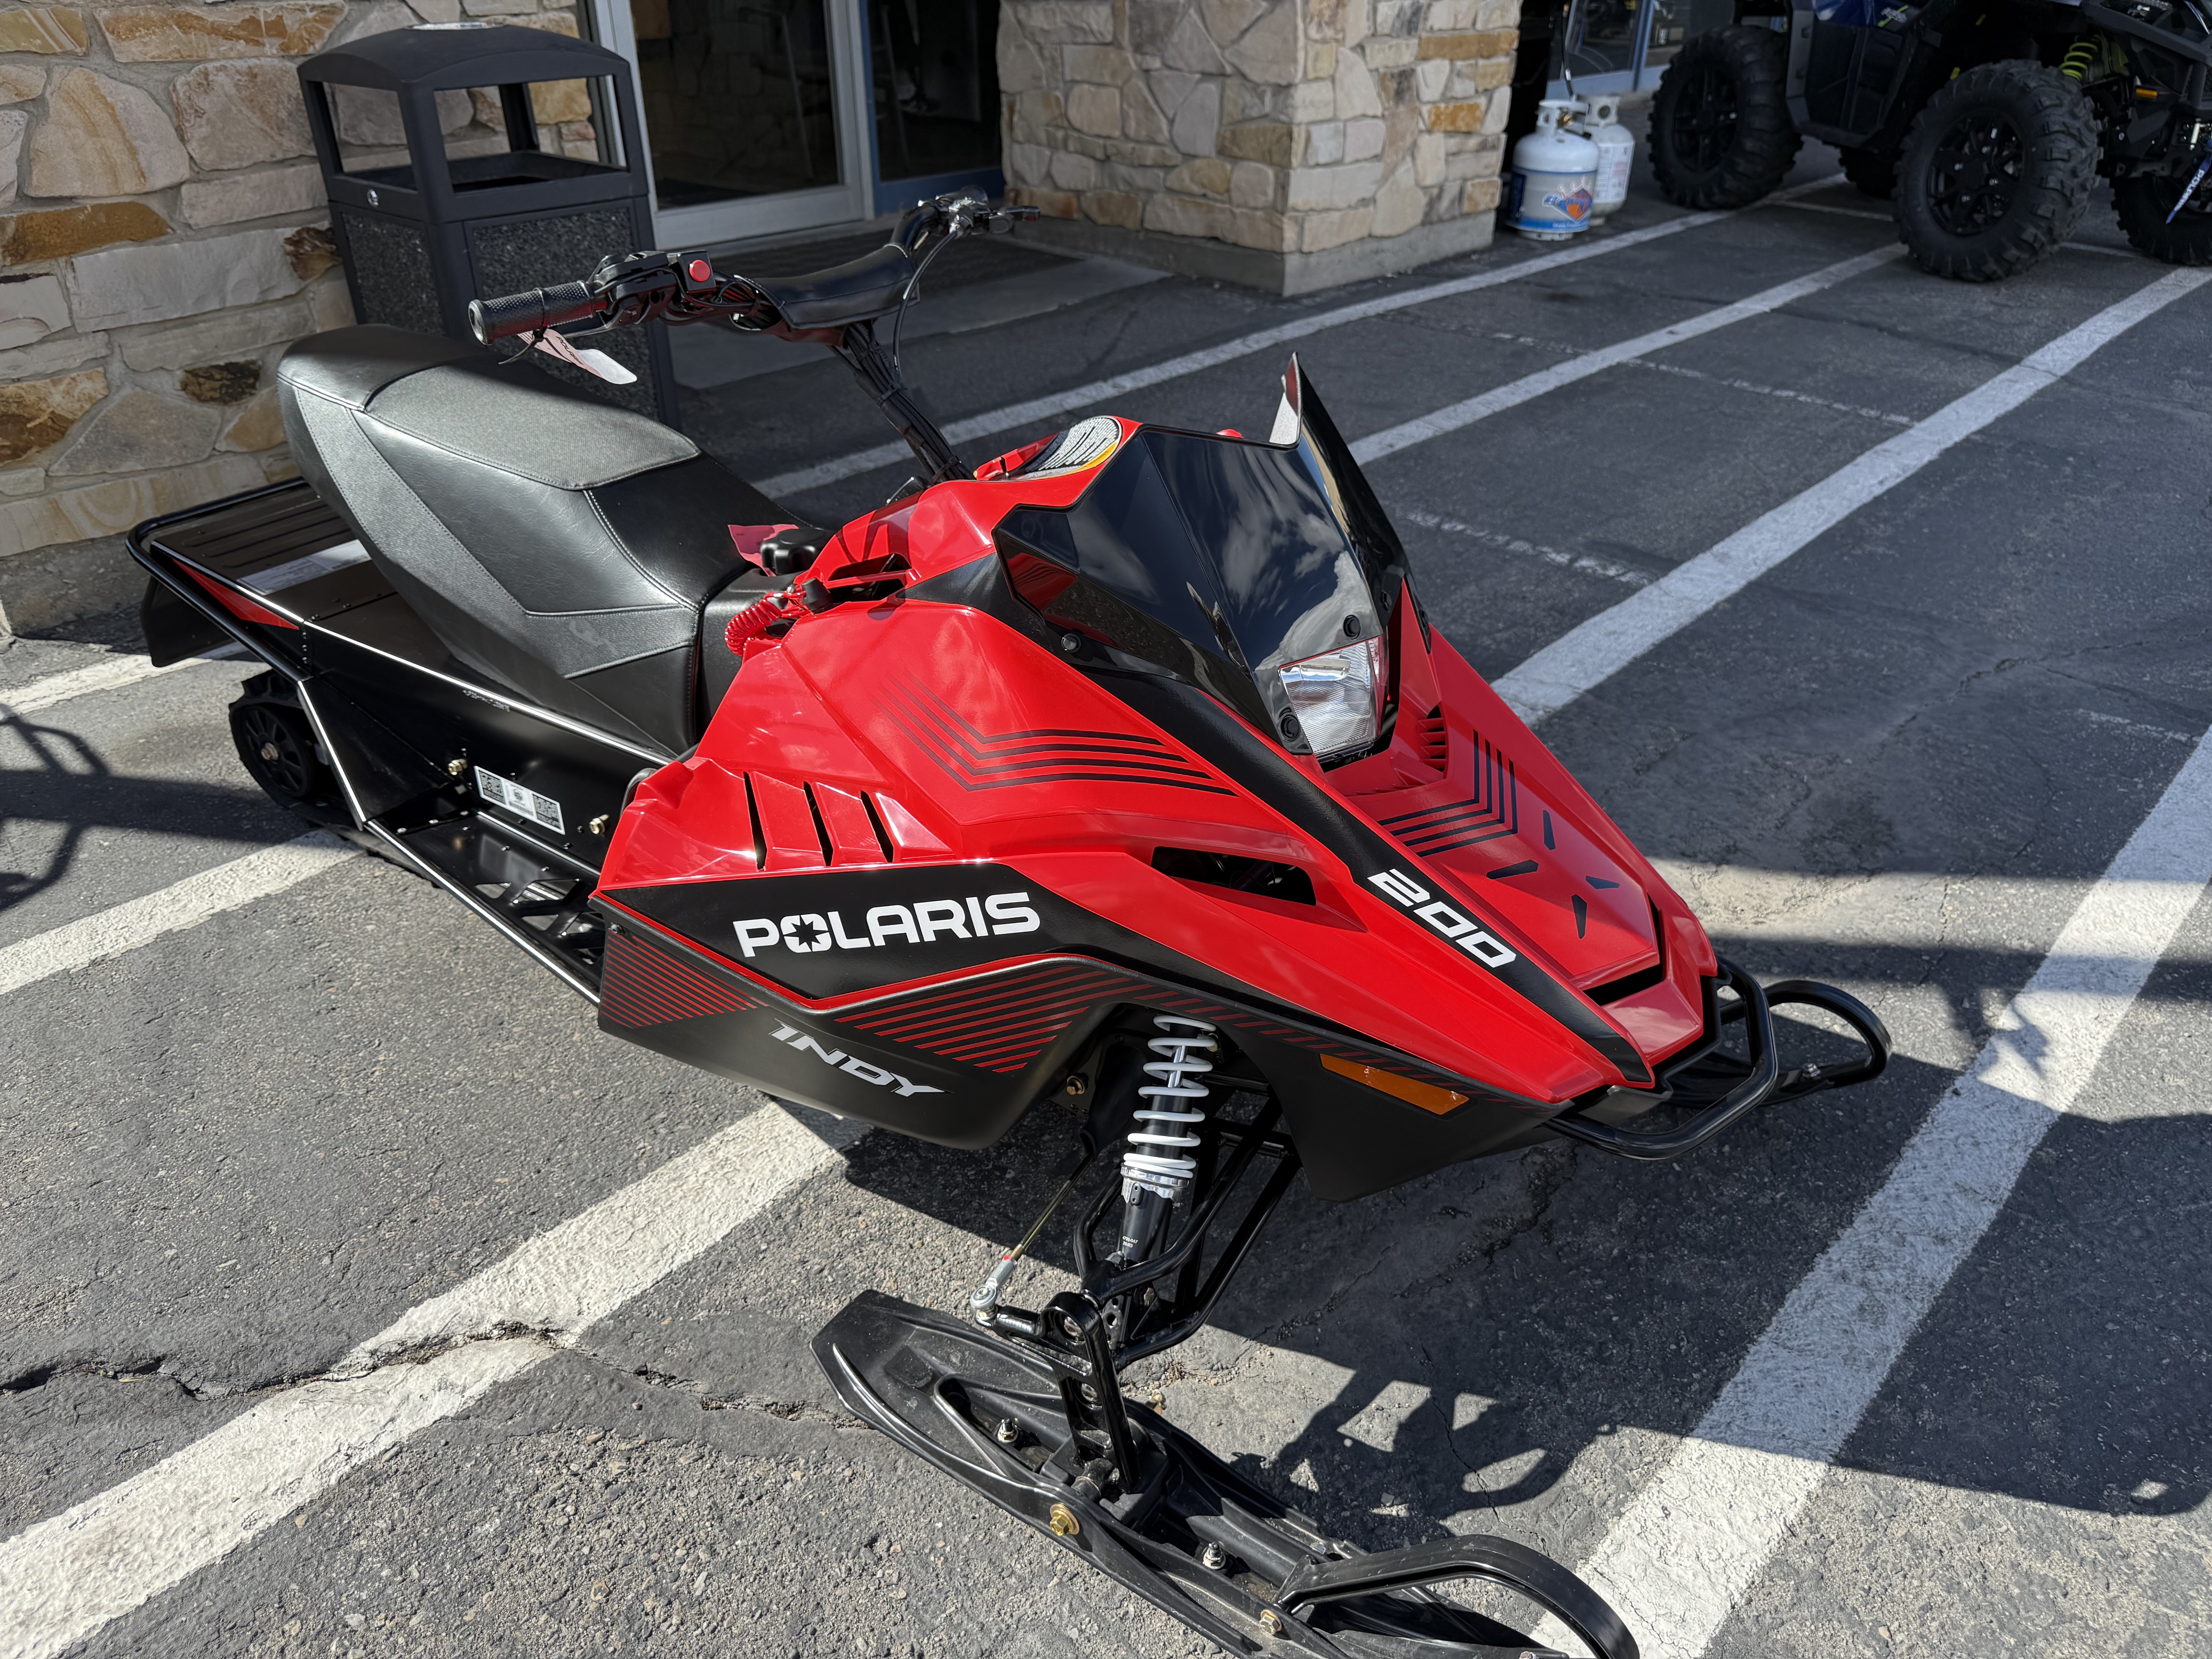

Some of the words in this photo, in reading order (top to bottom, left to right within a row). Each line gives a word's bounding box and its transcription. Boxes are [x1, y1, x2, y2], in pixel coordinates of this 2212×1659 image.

[555, 336, 584, 365] POLAR
[732, 892, 1040, 957] POLARIS
[1367, 869, 1516, 968] 200
[768, 1018, 953, 1097] INDY
